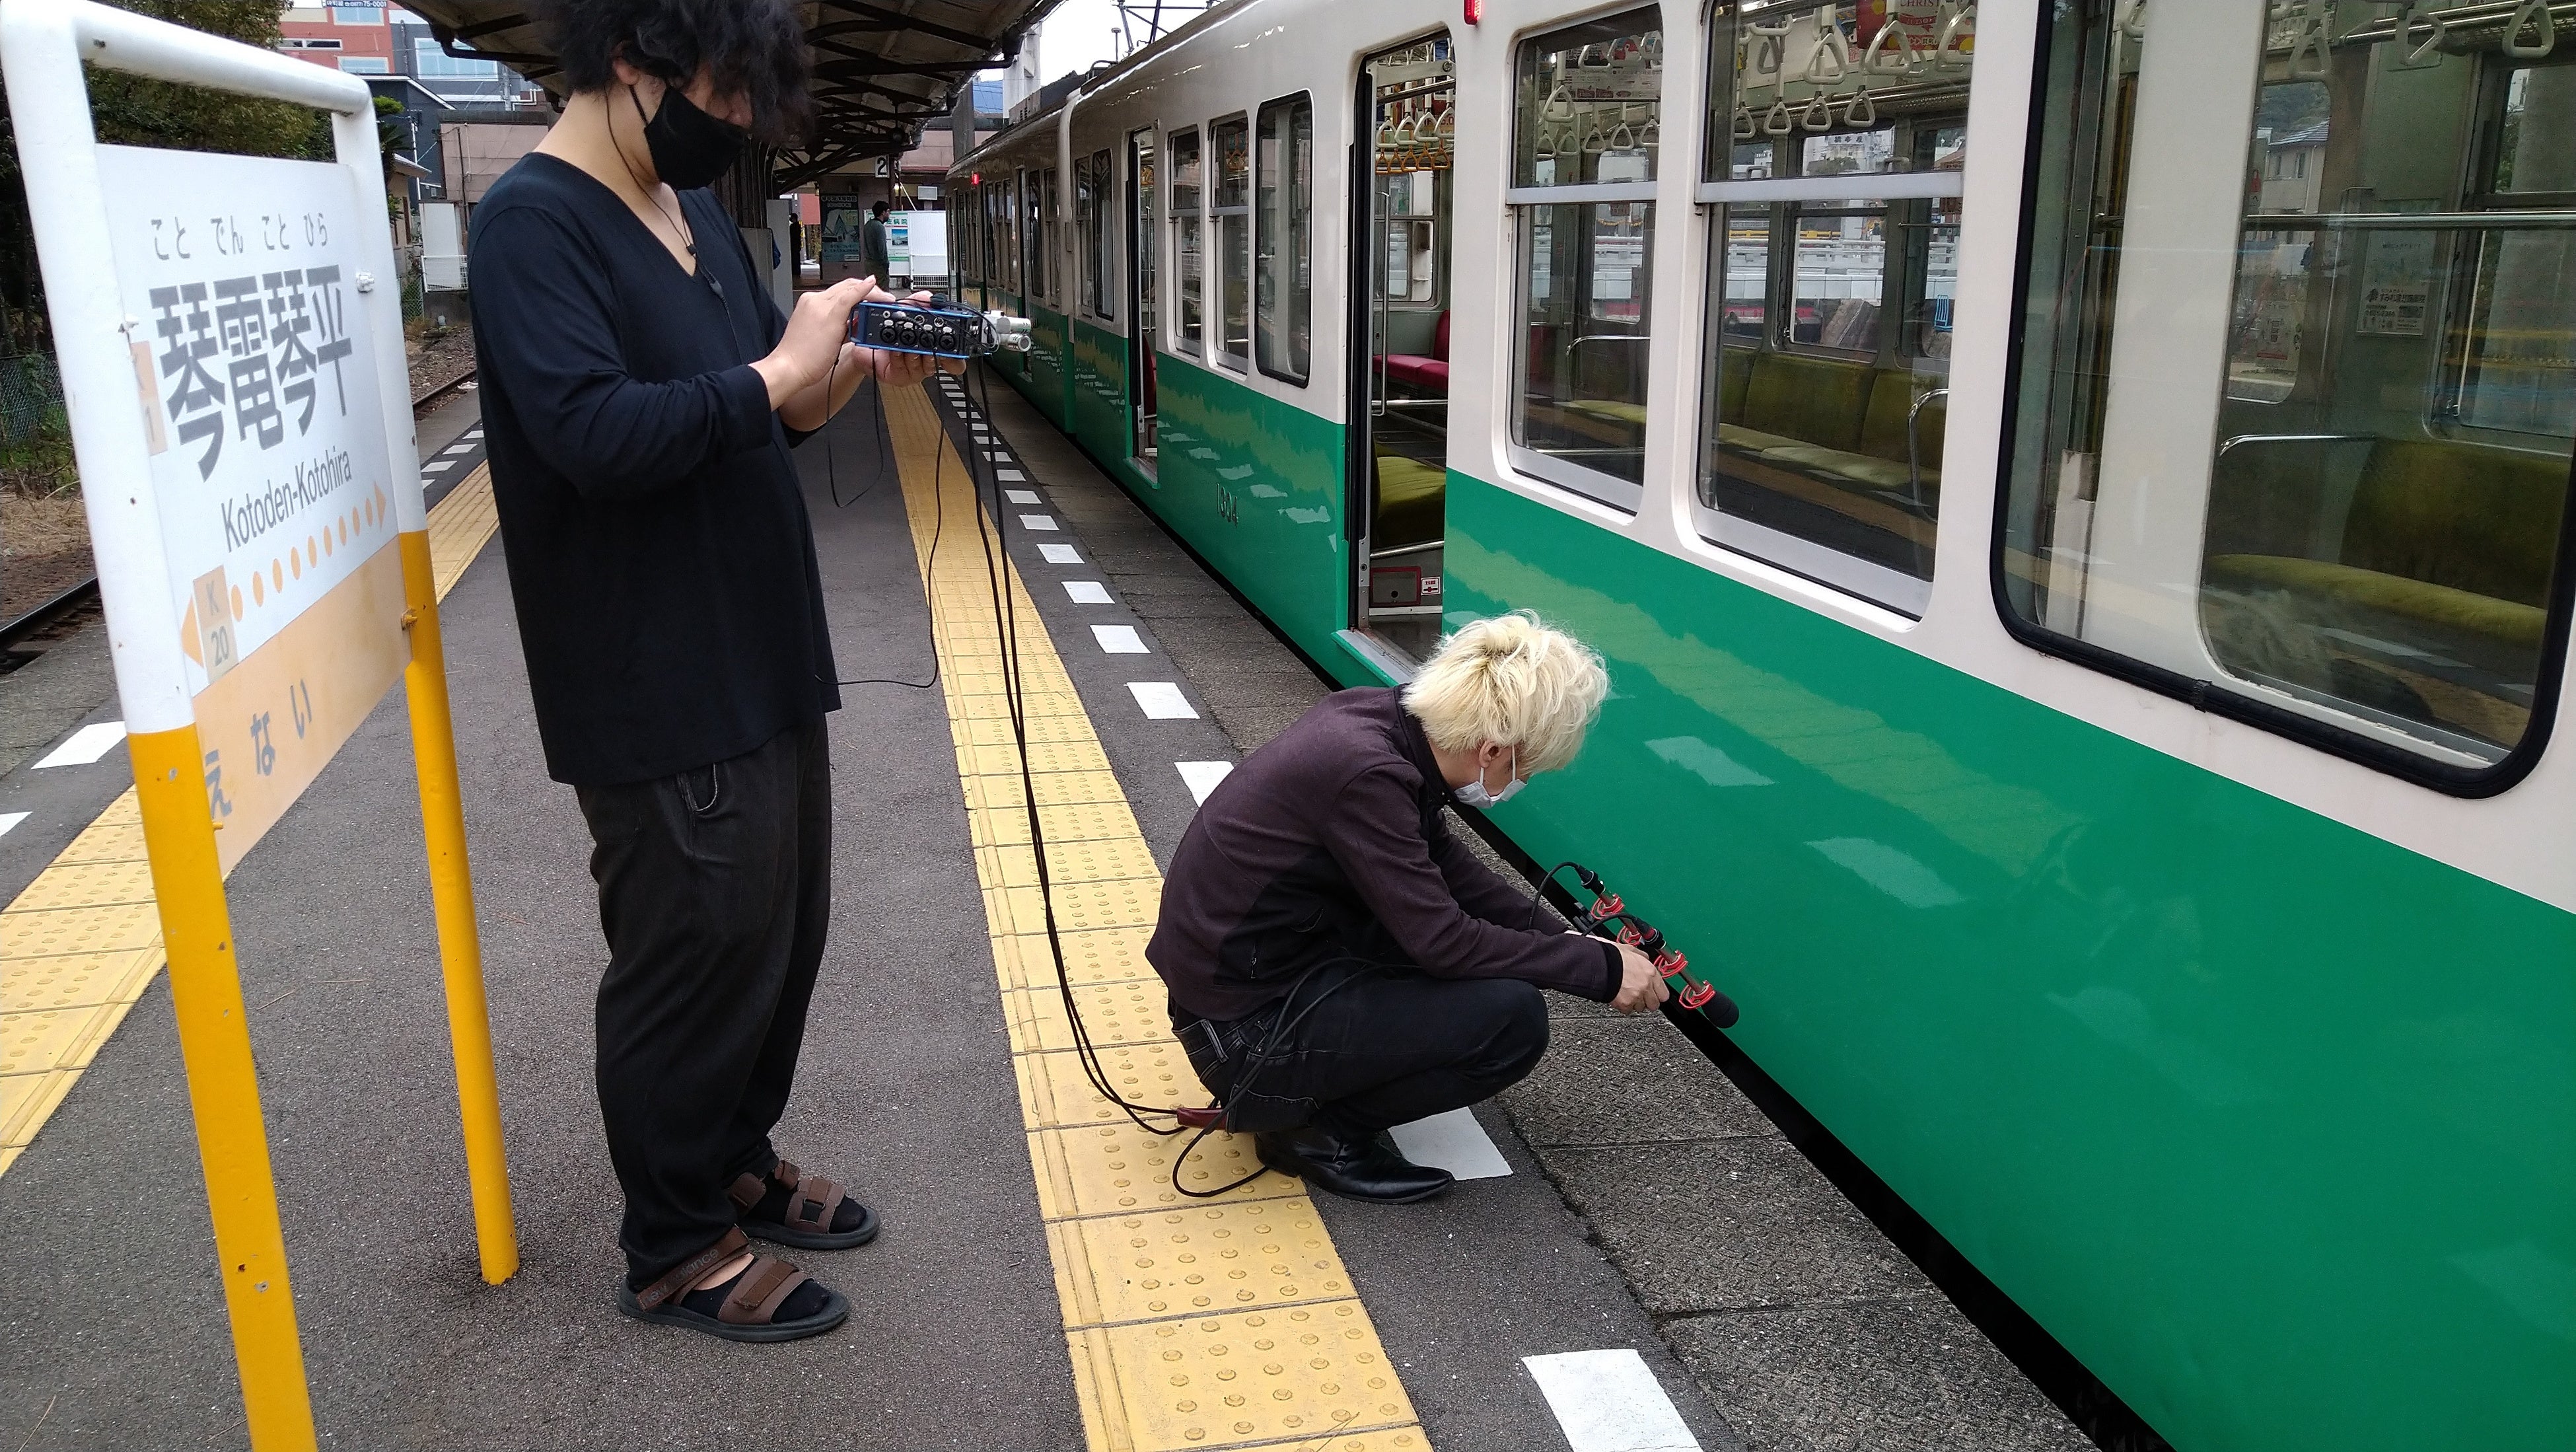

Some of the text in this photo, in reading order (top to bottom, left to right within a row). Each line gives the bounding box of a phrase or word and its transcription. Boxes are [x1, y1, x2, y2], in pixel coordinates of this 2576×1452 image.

[877, 157, 888, 176] 2
[151, 212, 328, 260] こと でん こと ひら
[149, 264, 353, 483] 琴電琴平
[221, 445, 352, 553] Kotoden-Kotohira
[206, 579, 219, 616] K
[210, 625, 229, 667] 20
